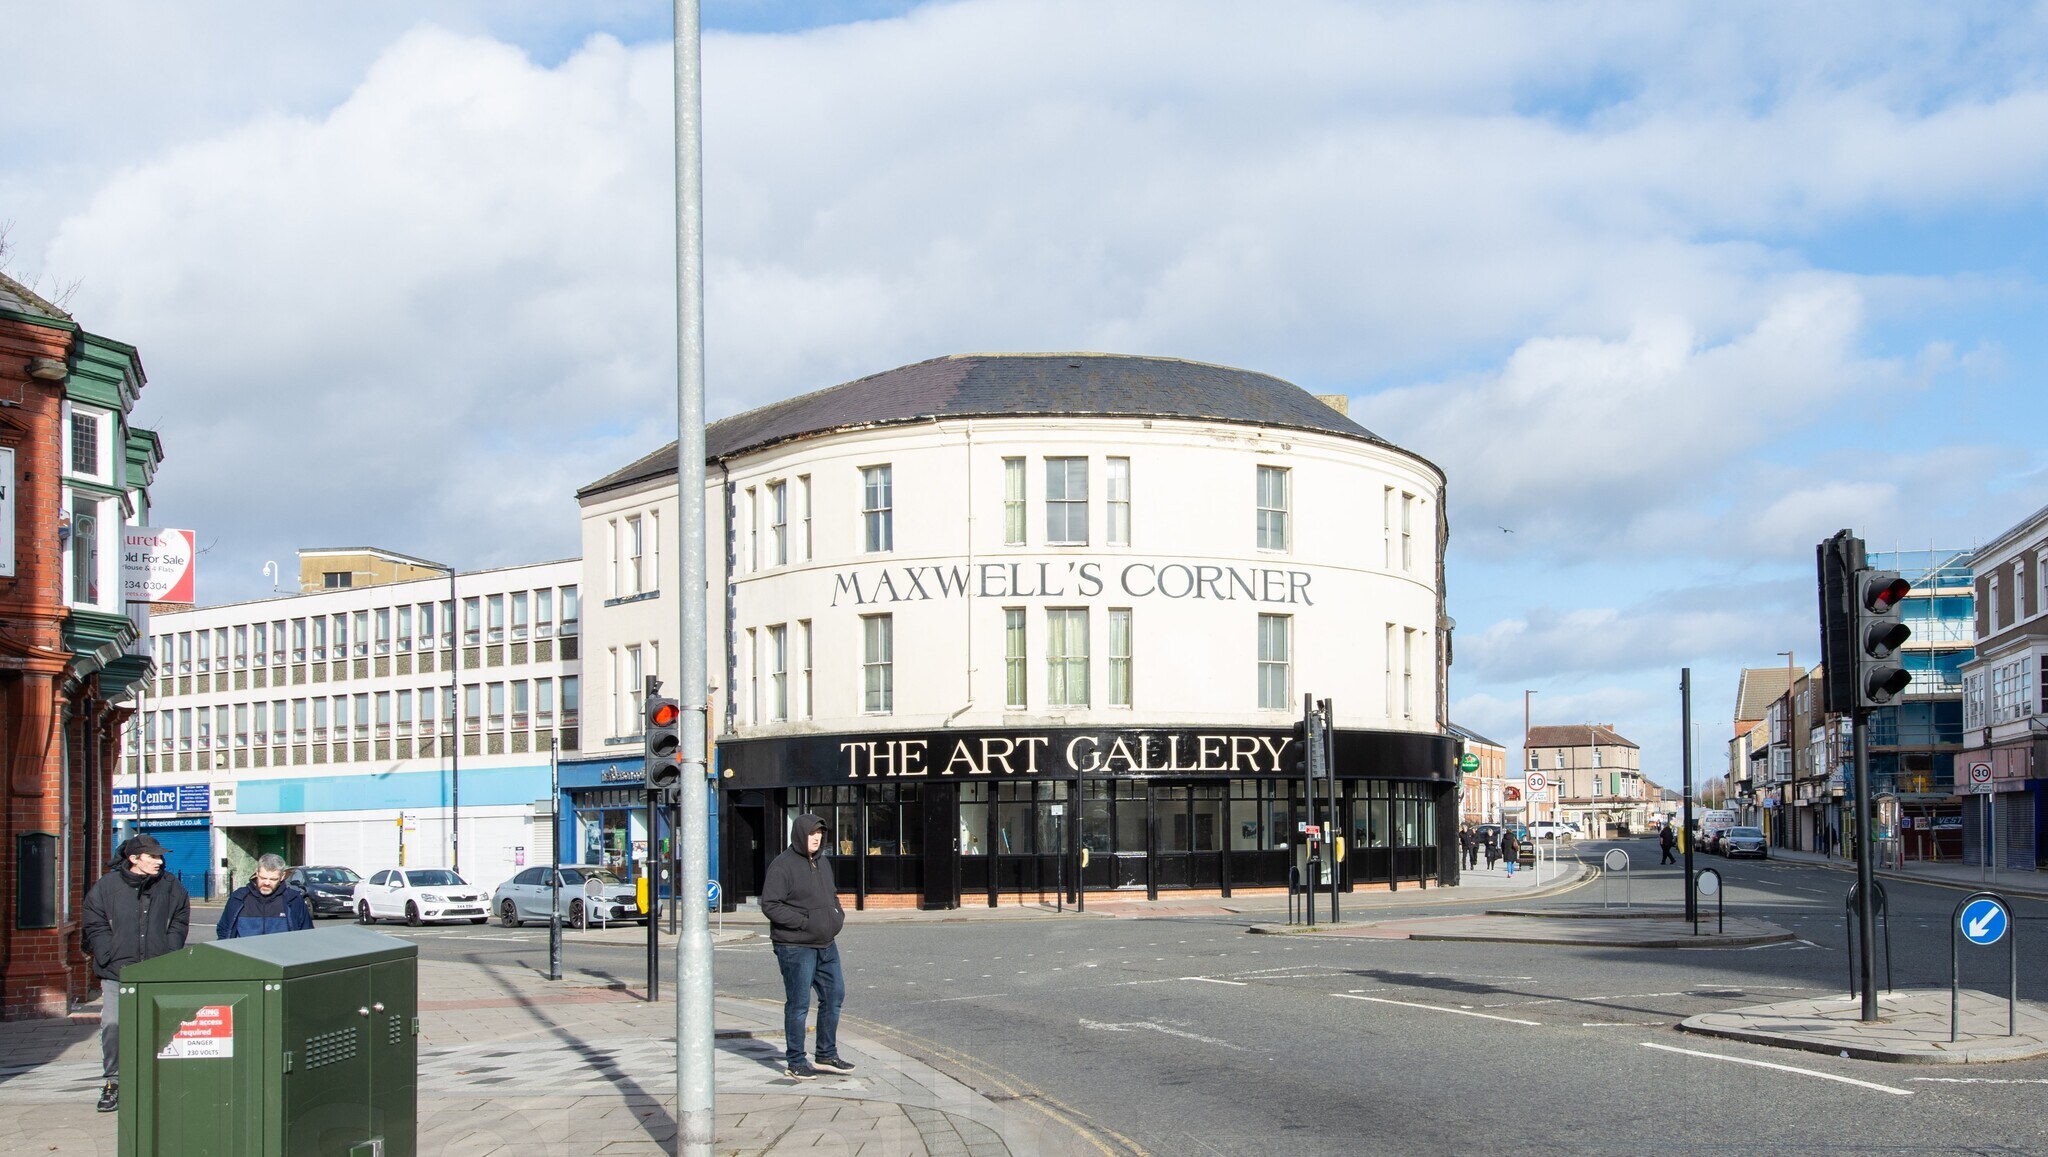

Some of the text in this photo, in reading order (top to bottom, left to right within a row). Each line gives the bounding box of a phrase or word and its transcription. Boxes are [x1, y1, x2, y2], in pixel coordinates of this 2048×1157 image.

[142, 553, 160, 564] For
[162, 554, 185, 566] Sale
[142, 581, 168, 590] 0304
[831, 562, 1314, 607] MAXWELL'S CORNER
[840, 735, 1294, 778] THE ART GALLERY
[1974, 768, 1989, 778] 30
[1530, 778, 1544, 786] 30
[140, 789, 176, 804] Centre
[180, 1028, 212, 1037] required
